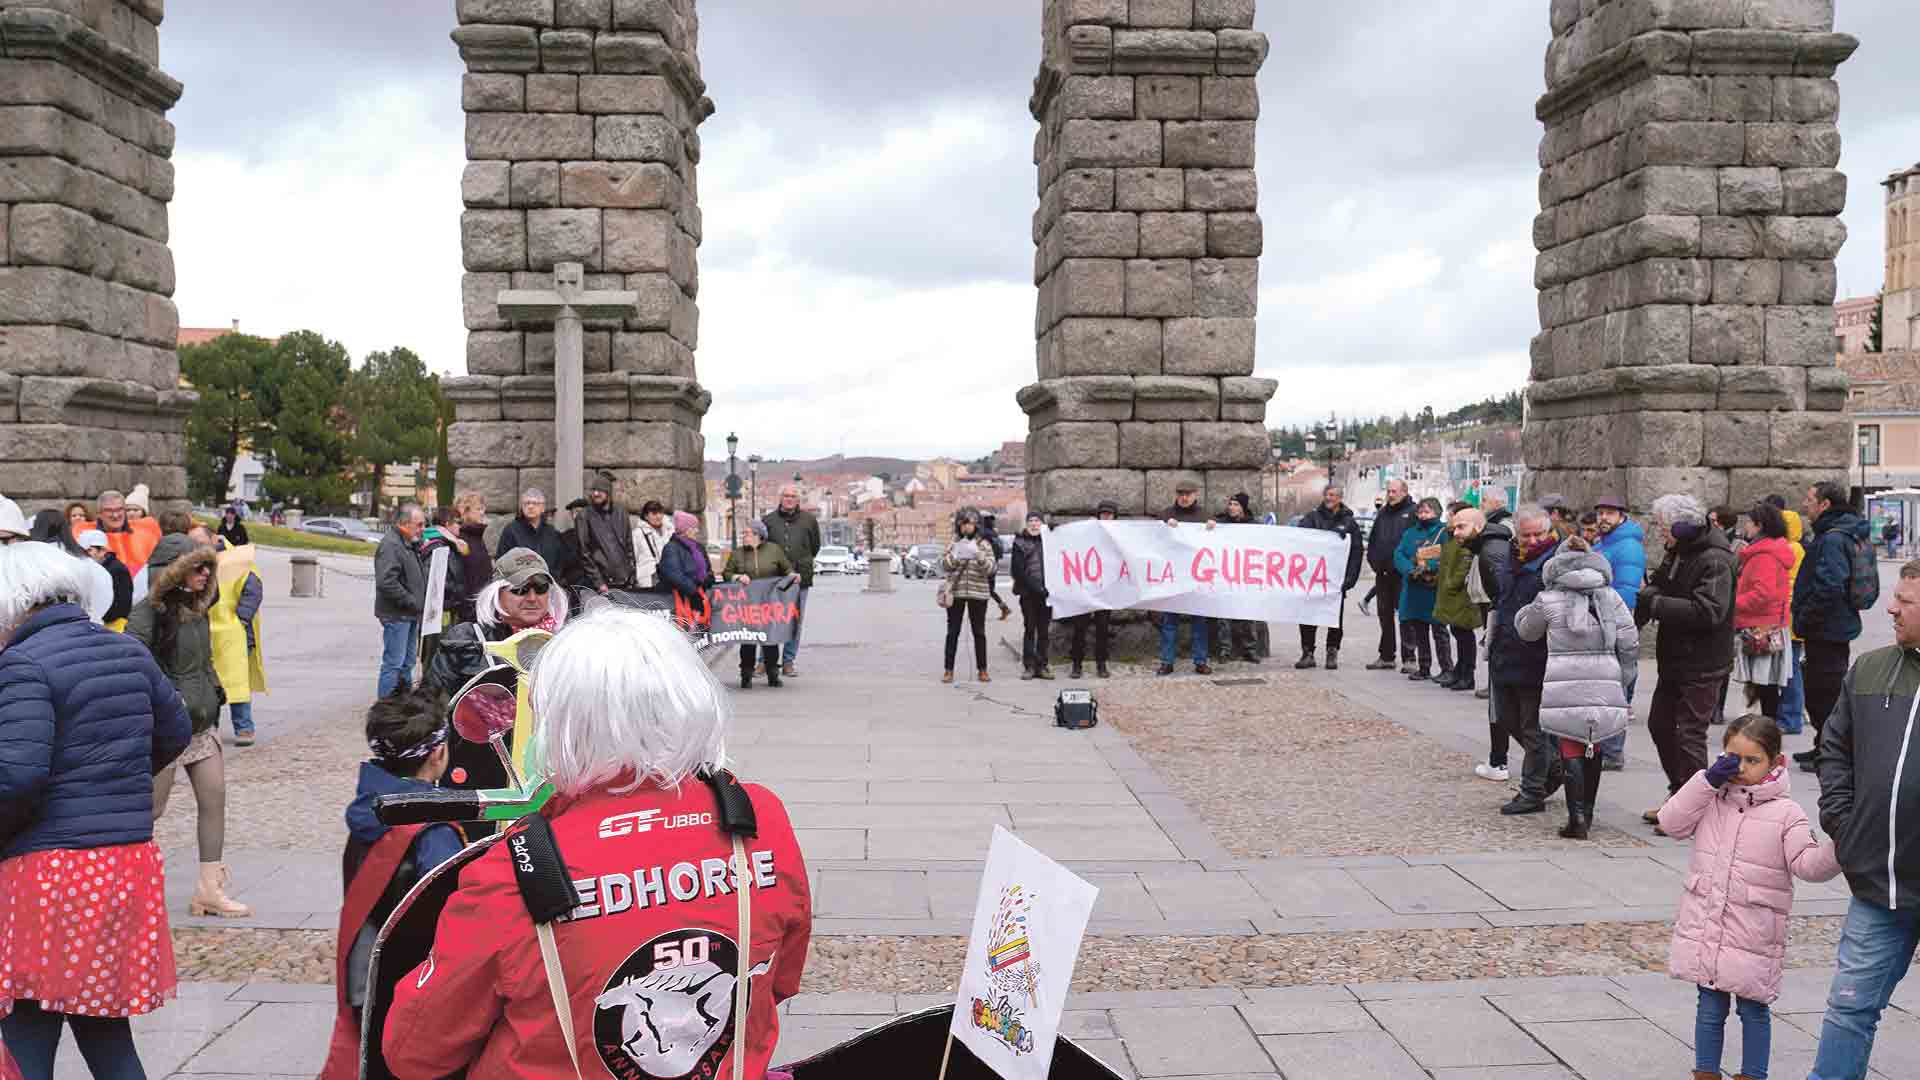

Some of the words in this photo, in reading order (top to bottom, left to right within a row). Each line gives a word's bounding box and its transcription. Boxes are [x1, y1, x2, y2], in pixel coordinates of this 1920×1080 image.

[1061, 546, 1102, 585] NO
[1119, 560, 1131, 579] A
[1146, 560, 1175, 584] LA
[1191, 547, 1329, 593] GUERRA
[713, 589, 723, 602] A
[727, 587, 747, 601] LA
[721, 602, 799, 625] GUERRA
[711, 627, 768, 643] nombre
